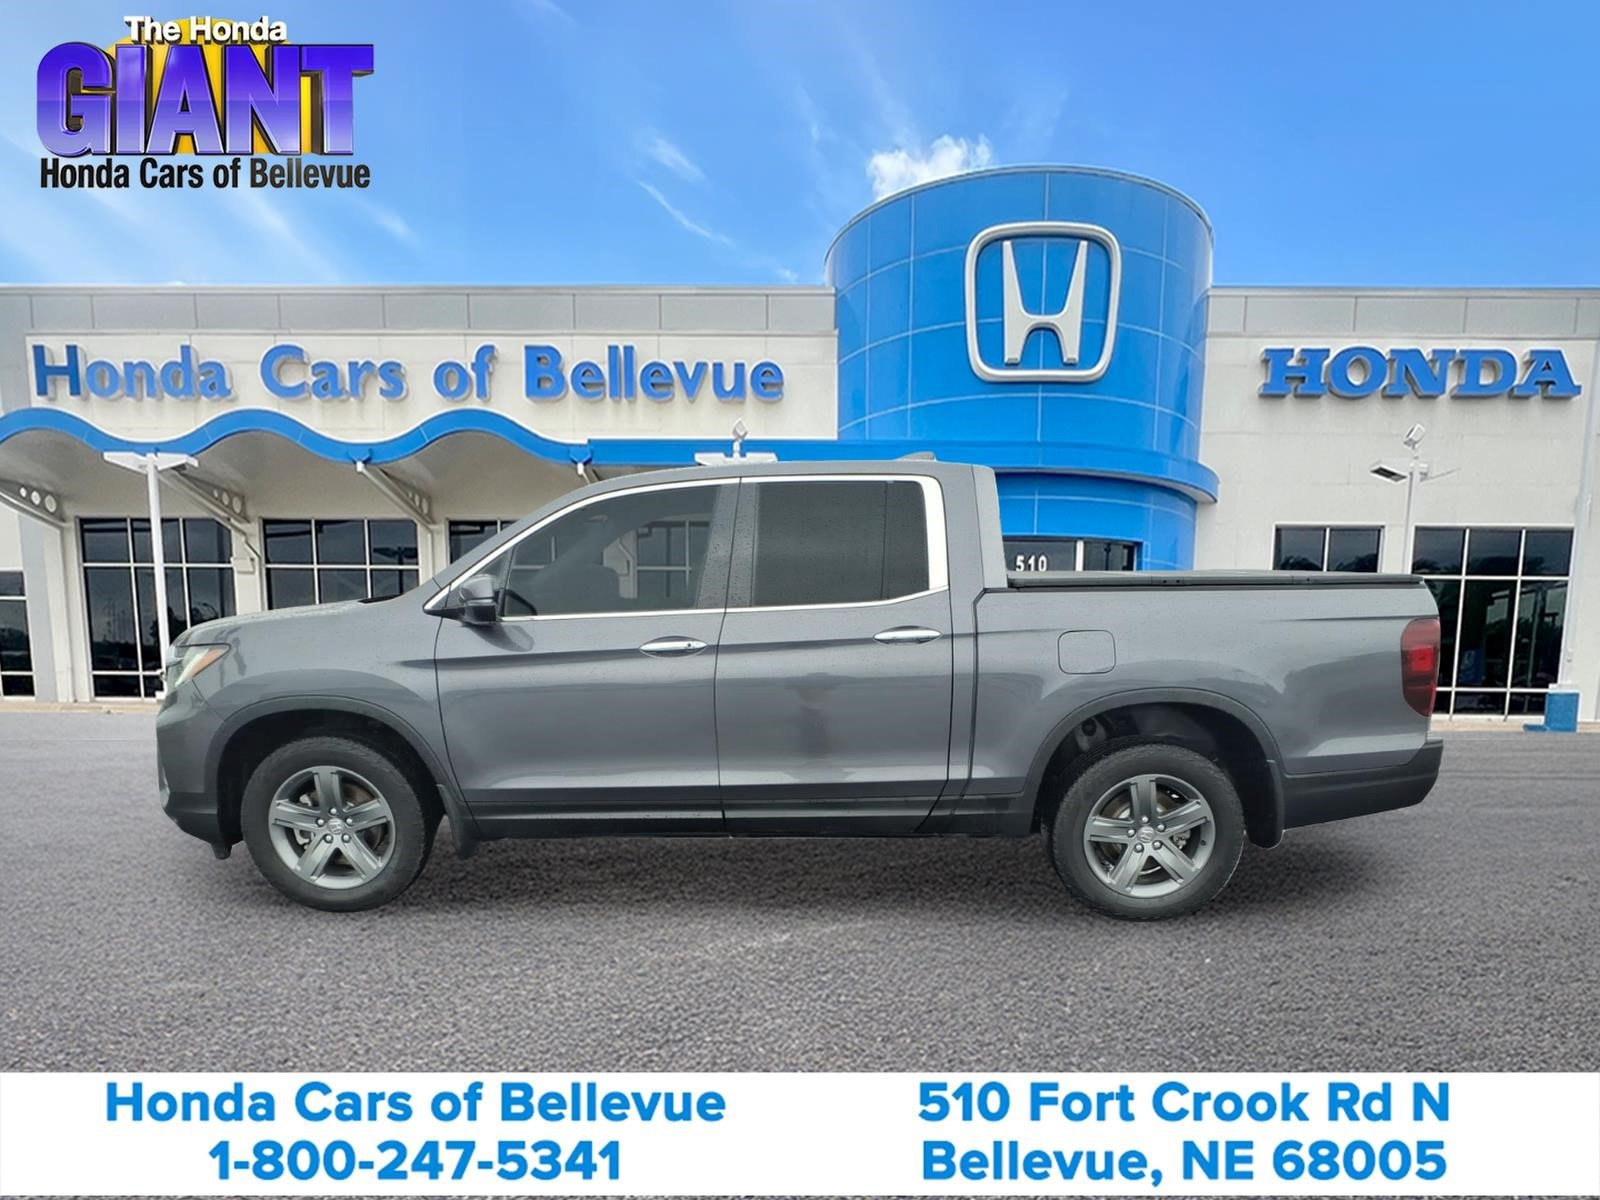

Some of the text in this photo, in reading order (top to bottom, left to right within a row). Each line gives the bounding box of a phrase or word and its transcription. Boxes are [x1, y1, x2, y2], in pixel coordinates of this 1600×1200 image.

[32, 343, 785, 401] Honda Cars of Bellevue
[1259, 347, 1582, 399] HONDA
[1015, 554, 1048, 572] 510
